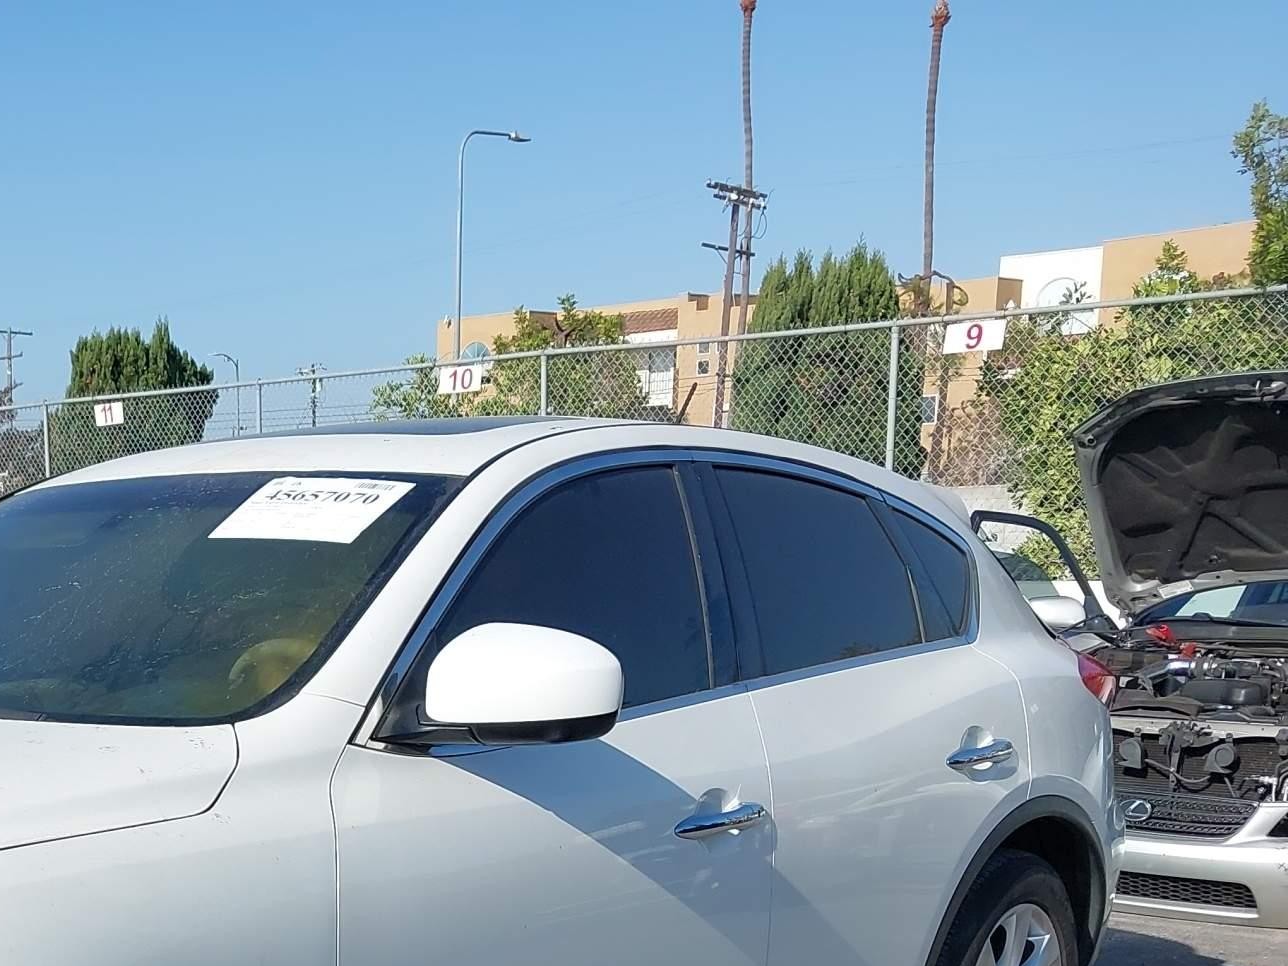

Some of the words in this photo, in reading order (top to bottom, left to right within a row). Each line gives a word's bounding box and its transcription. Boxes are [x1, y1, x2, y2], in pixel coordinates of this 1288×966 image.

[965, 323, 983, 349] 9
[449, 368, 472, 391] 10
[101, 403, 113, 424] 11
[265, 489, 380, 505] 45657070
